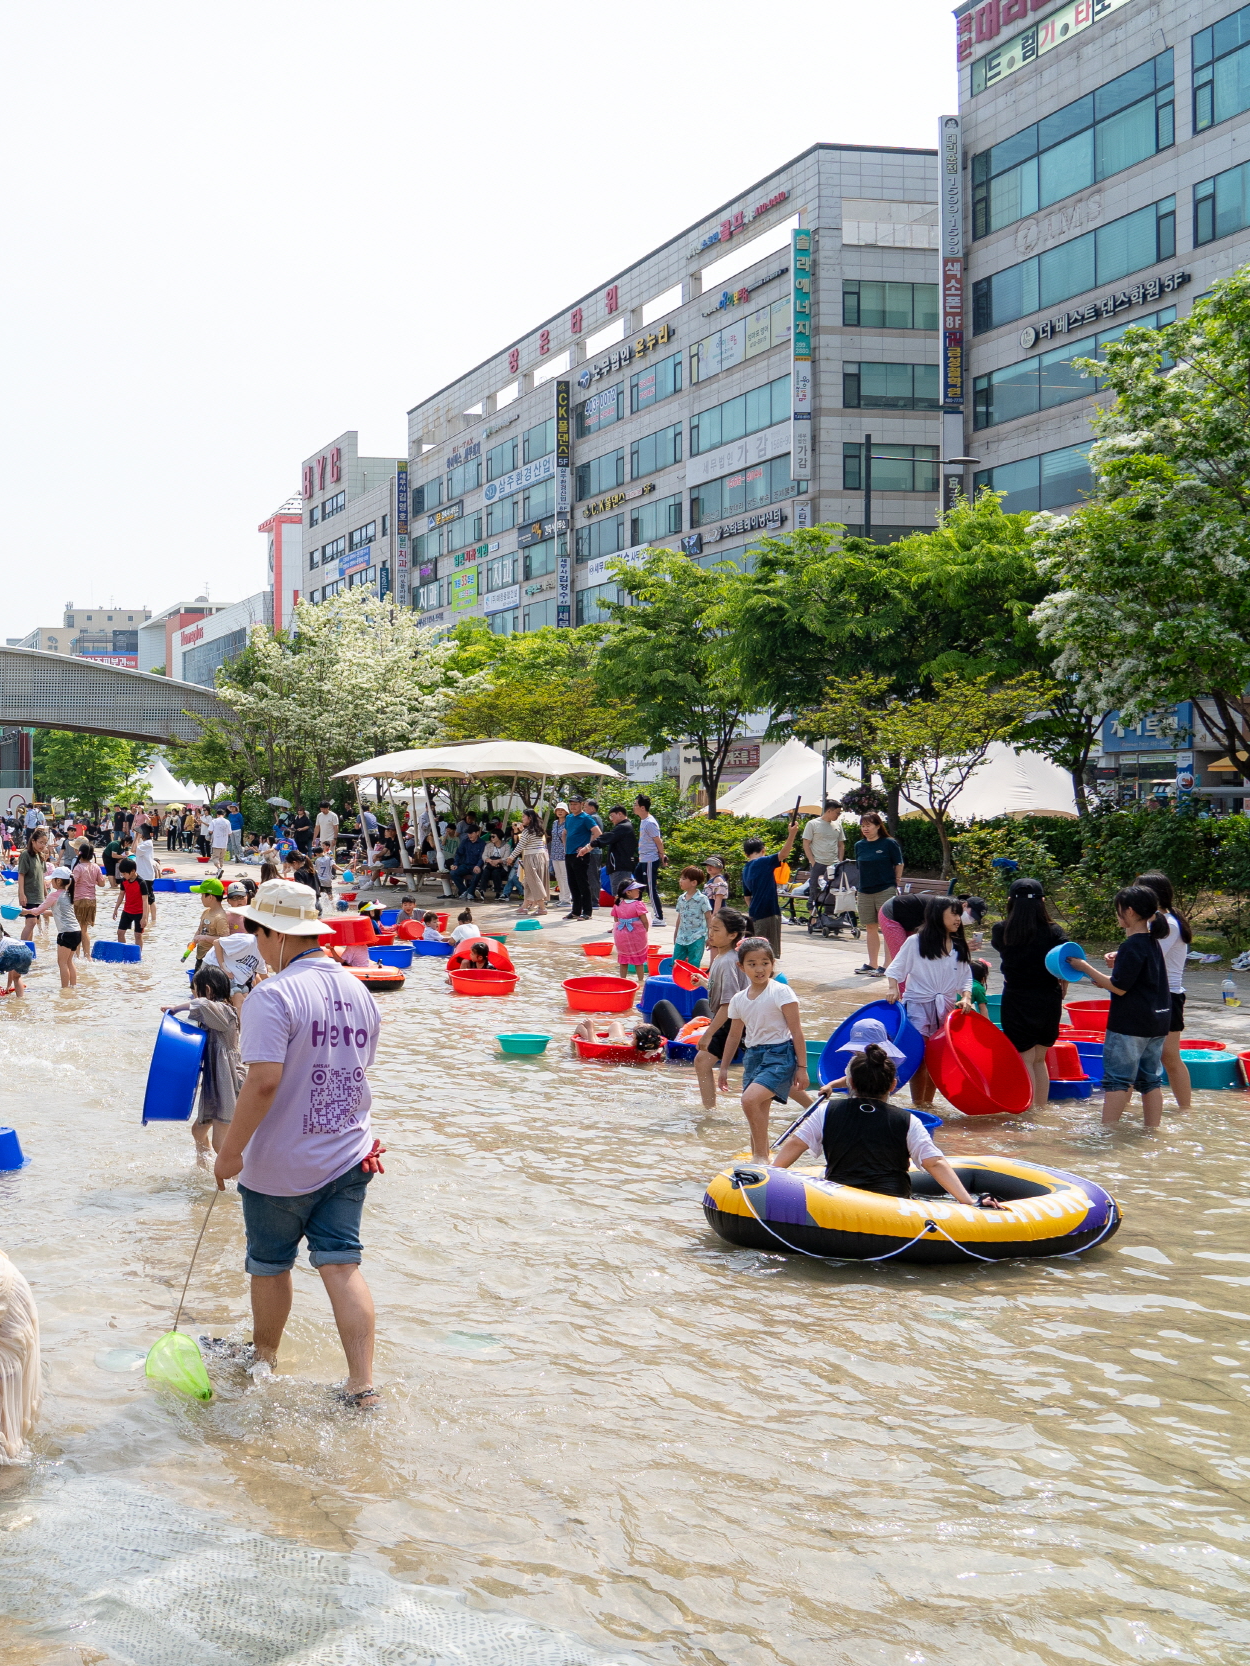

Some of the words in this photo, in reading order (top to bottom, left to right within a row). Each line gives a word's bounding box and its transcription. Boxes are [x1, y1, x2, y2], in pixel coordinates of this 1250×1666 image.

[720, 211, 744, 242] 골프
[945, 262, 961, 313] 색소폰
[1039, 320, 1053, 340] 더
[1055, 304, 1097, 333] 베스트
[1100, 278, 1161, 318] 댄스학원
[1164, 272, 1184, 292] 5F
[945, 316, 961, 329] 8F
[592, 345, 631, 381] 노무법인
[635, 323, 669, 358] 온누리
[302, 447, 340, 500] BYC
[499, 458, 551, 494] 삼주환경산업
[558, 458, 568, 466] 5F
[493, 557, 513, 587] 치과
[419, 583, 438, 609] 치과
[320, 866, 327, 877] 7
[334, 1000, 353, 1012] am
[312, 1020, 368, 1049] Hero
[897, 1190, 1096, 1224] ADVENTURE
